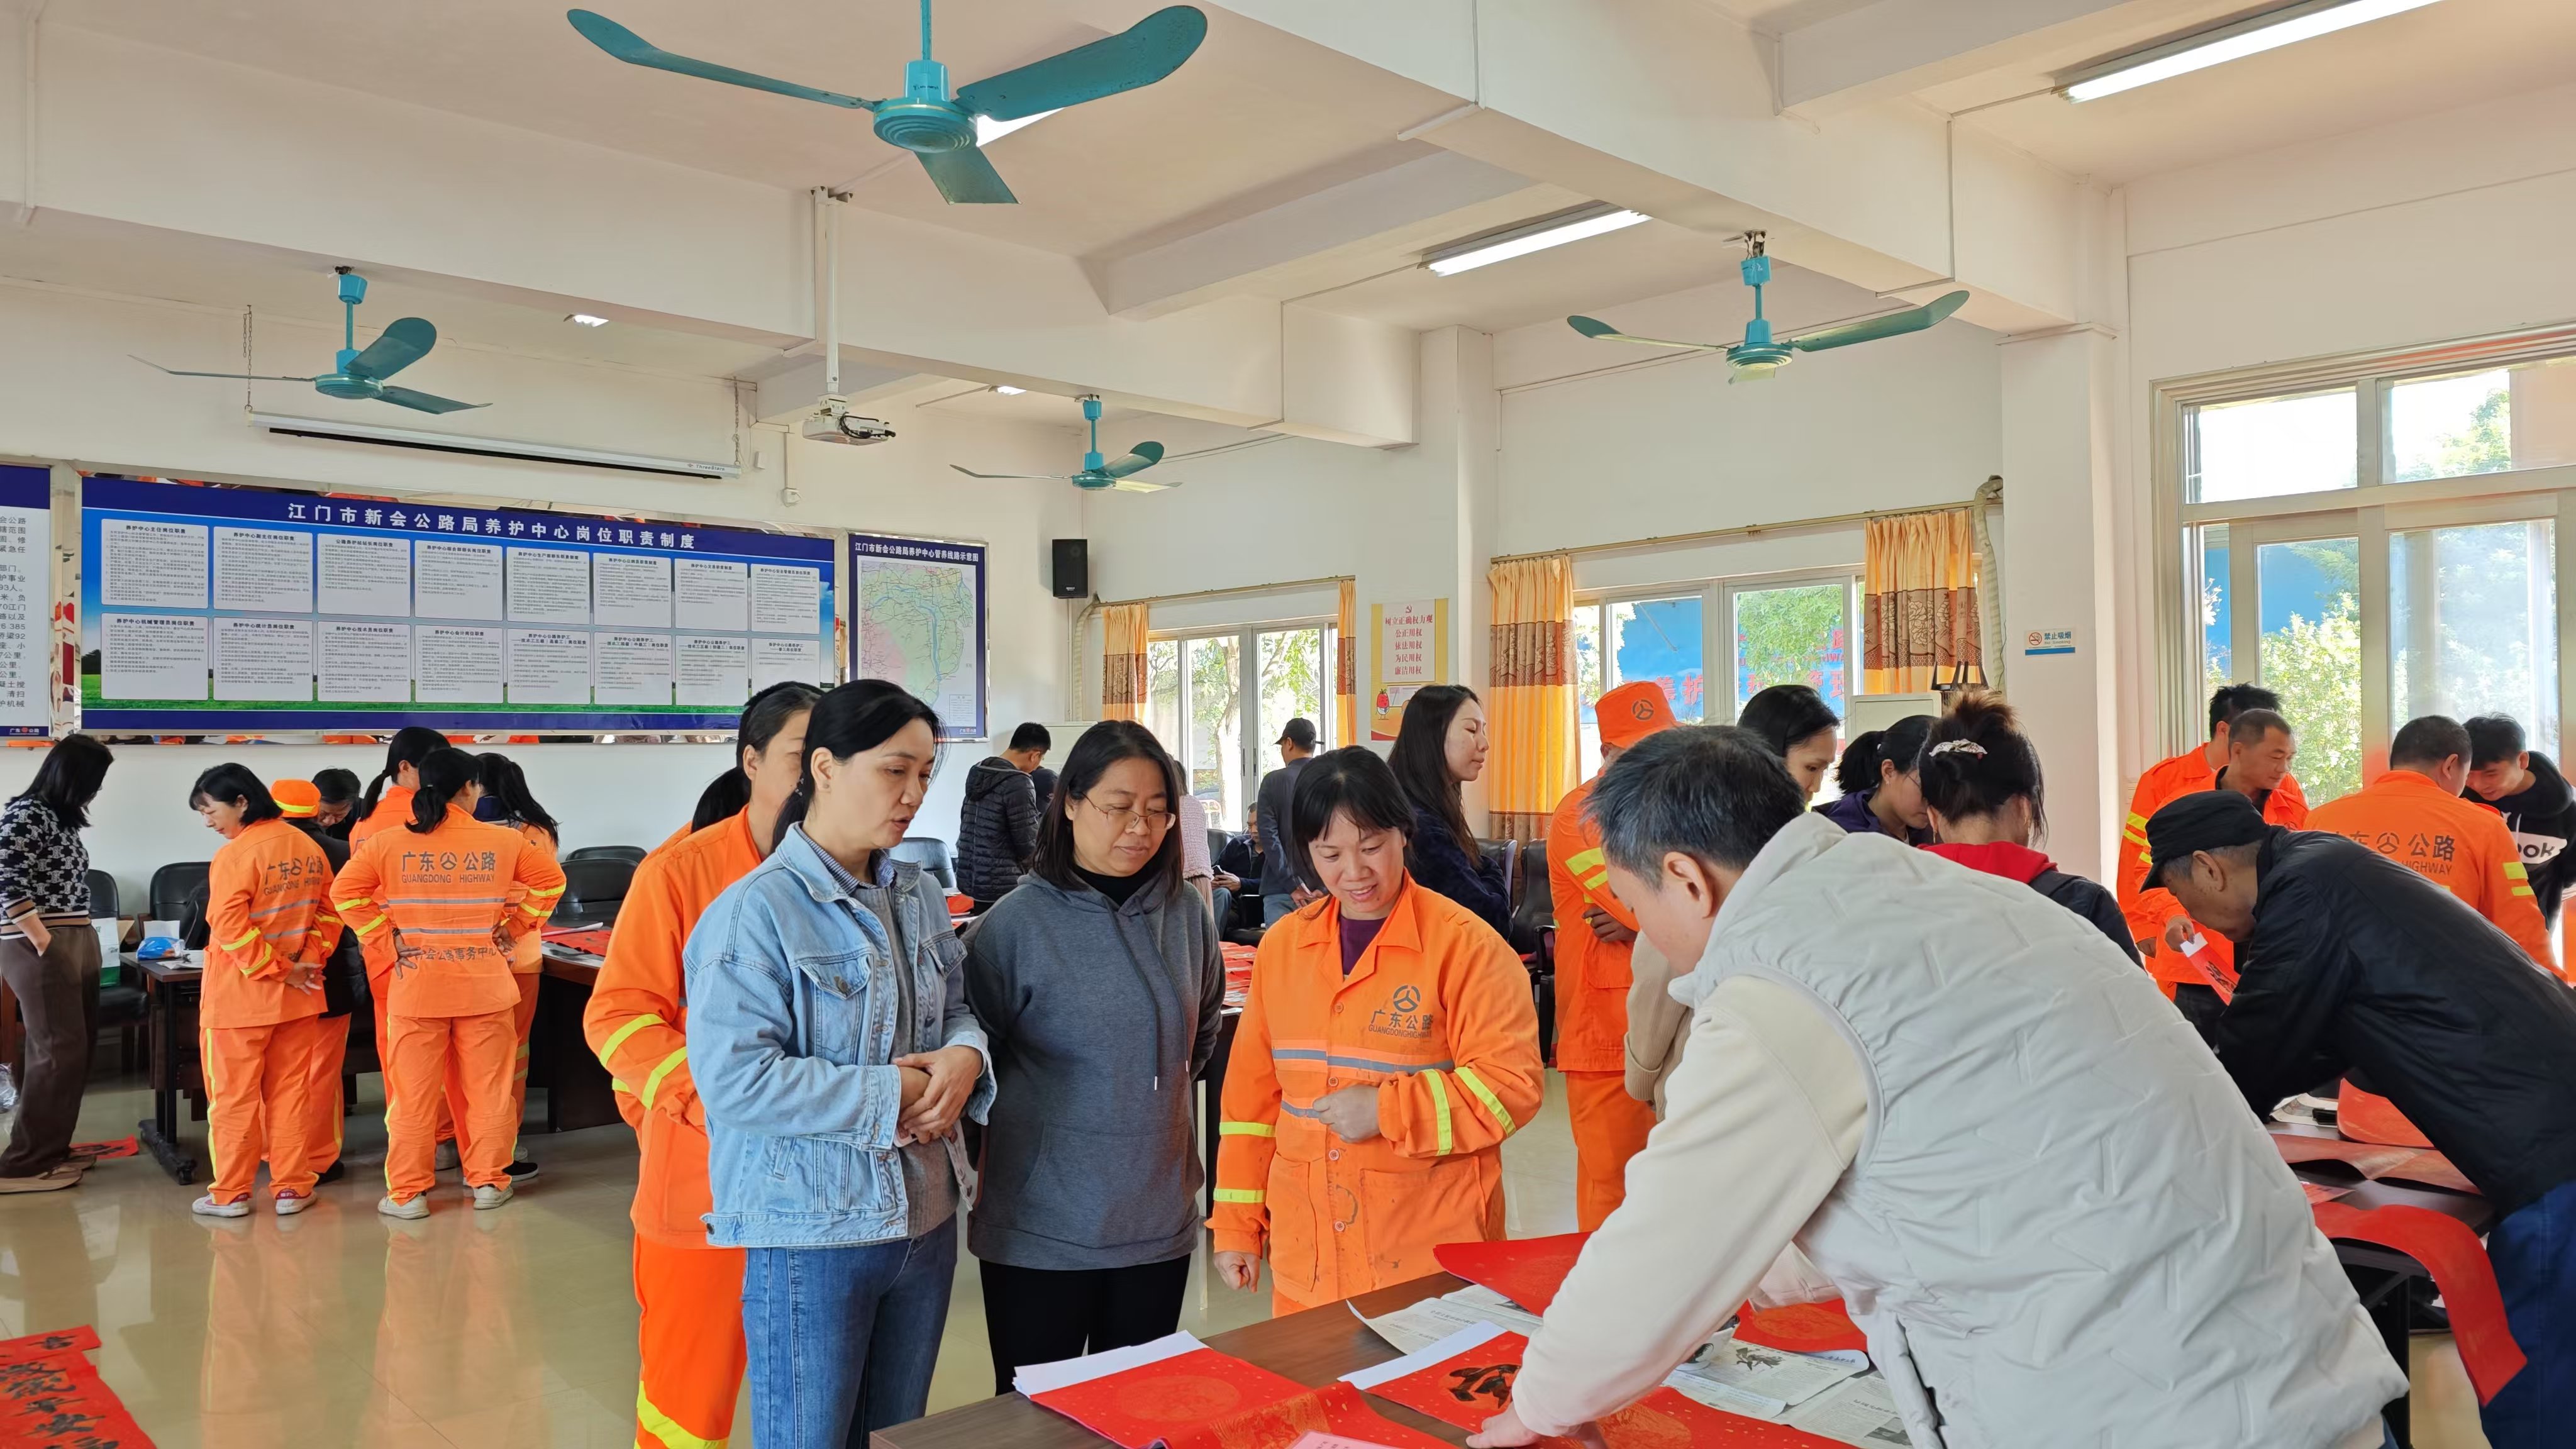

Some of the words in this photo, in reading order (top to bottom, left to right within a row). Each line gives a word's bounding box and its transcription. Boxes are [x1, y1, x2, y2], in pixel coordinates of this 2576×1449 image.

[287, 502, 695, 549] 江门市新会公路局养护中心岗位职责制度
[855, 542, 979, 562] 江门市新会公路局养护中心管养线路示意图
[1395, 628, 1423, 638] 公正用权
[1395, 640, 1423, 650] 依法用权
[1396, 653, 1422, 663] 为民用权
[1394, 665, 1422, 675] 廉洁用权
[2407, 833, 2456, 862] 公路
[402, 851, 435, 872] 广东
[462, 851, 496, 872] 公路
[402, 874, 452, 884] GUANGDONG
[459, 873, 495, 883] HIGHWAY
